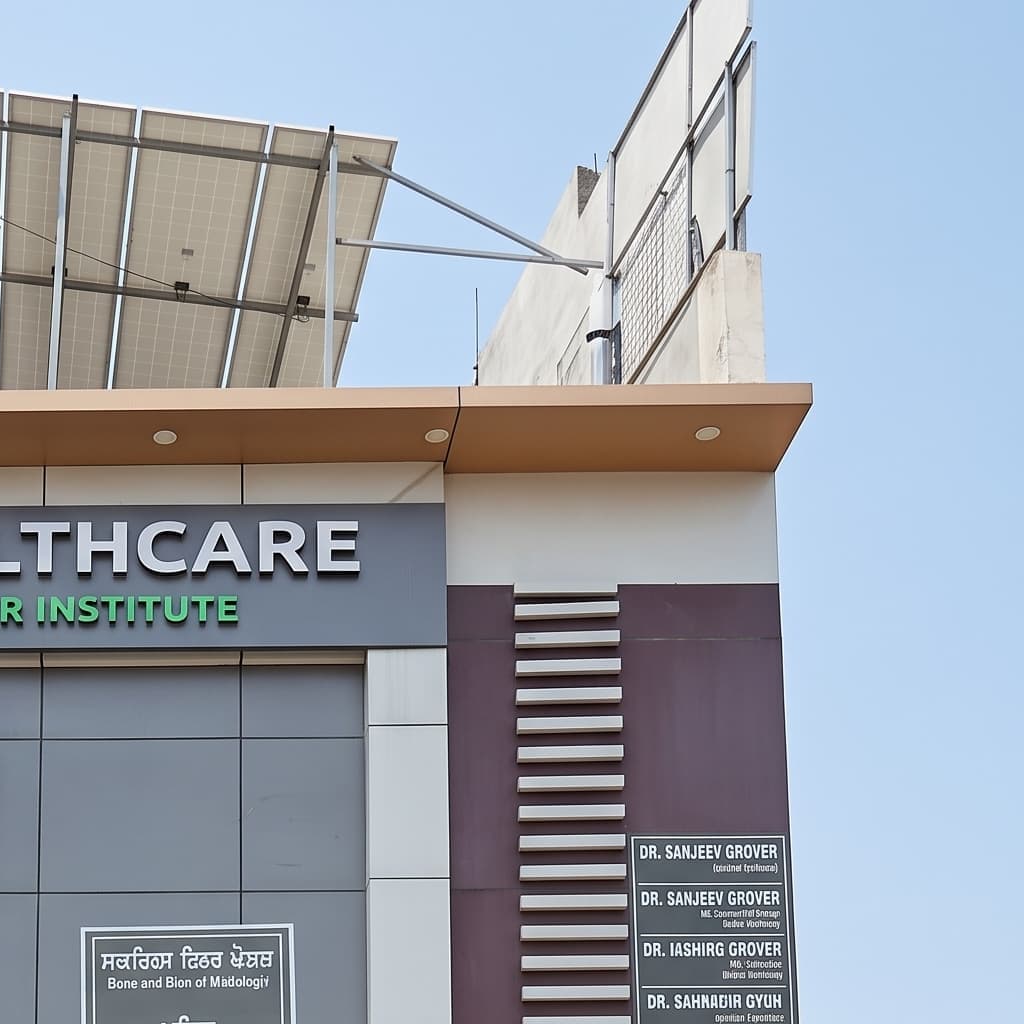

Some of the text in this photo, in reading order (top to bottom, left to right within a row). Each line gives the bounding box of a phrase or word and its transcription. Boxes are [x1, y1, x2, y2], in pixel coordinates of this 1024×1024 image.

[37, 595, 237, 622] INSTITUTE
[640, 845, 777, 859] DR. SANJEEV GROVER
[642, 891, 779, 905] DR. SANJEEV GROVER
[644, 943, 665, 956] DR.
[729, 942, 781, 956] GROVER
[108, 978, 137, 989] Bone
[141, 977, 162, 988] and
[166, 976, 191, 988] Bion
[196, 976, 206, 987] of
[648, 995, 669, 1009] DR.
